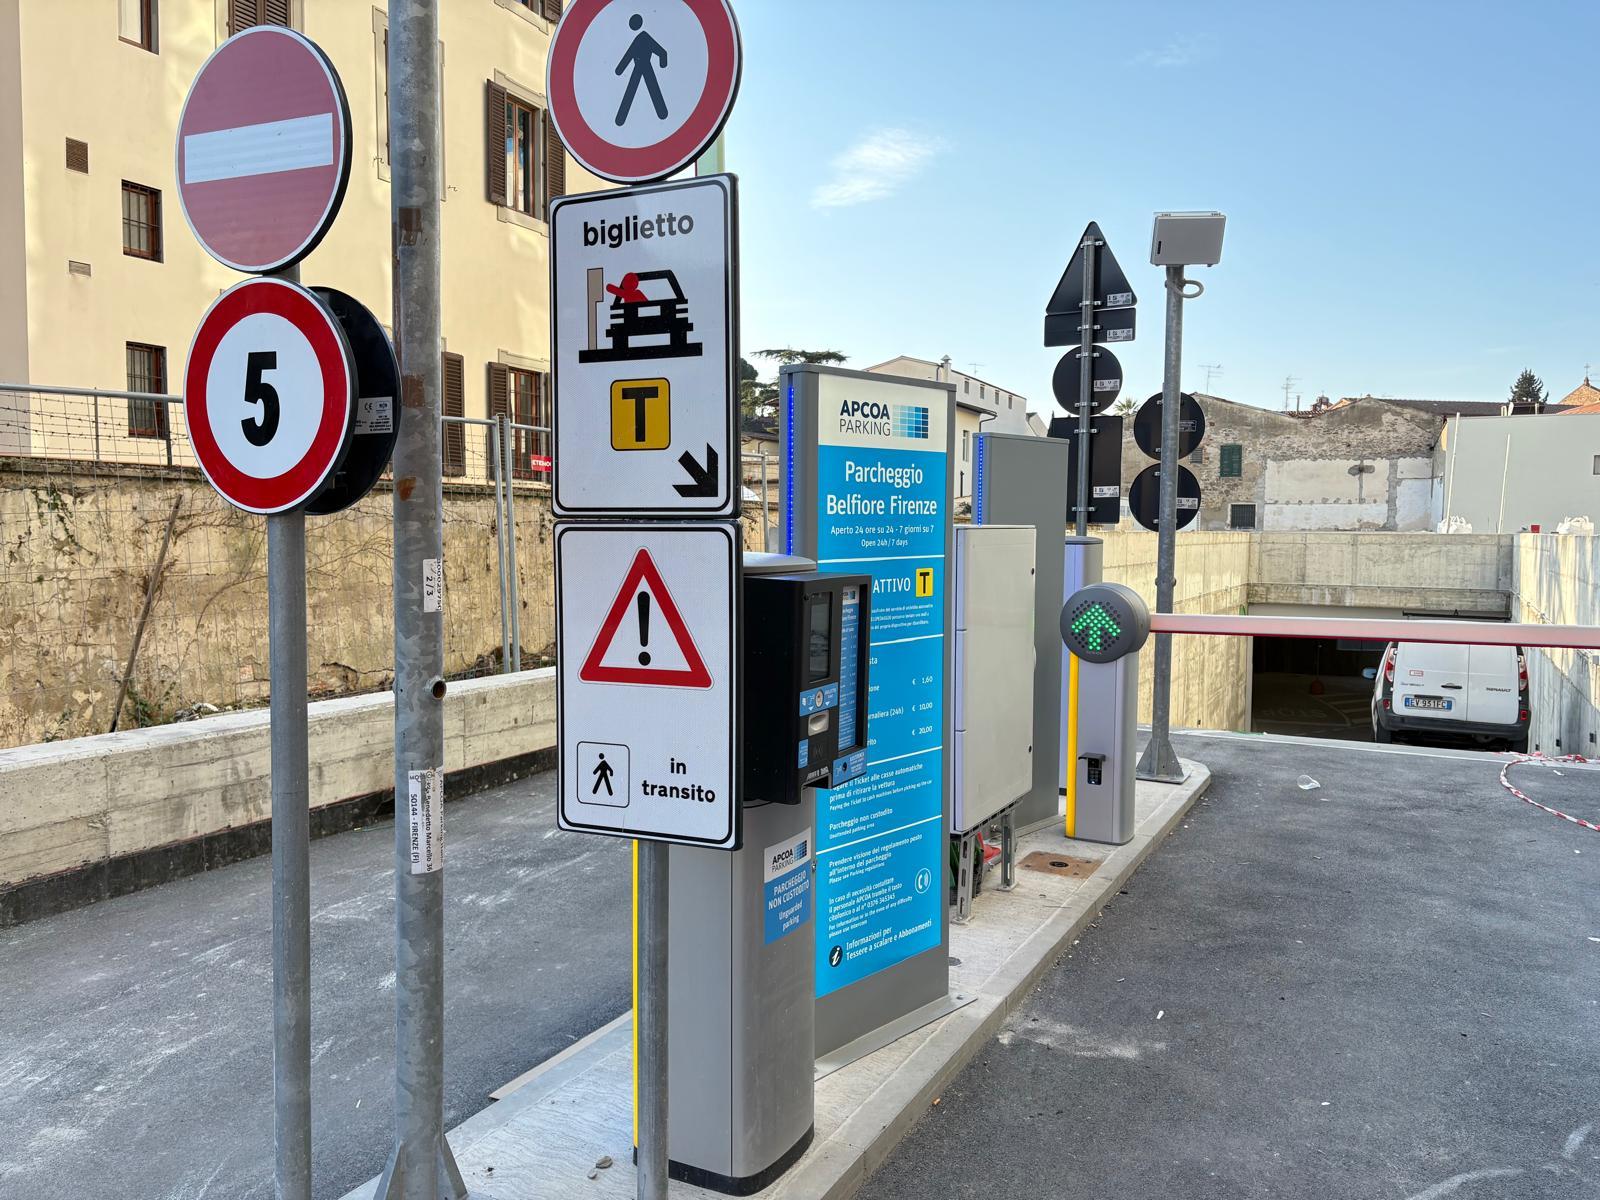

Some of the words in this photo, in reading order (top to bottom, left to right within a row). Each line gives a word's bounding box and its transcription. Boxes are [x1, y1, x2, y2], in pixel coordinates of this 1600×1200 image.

[583, 212, 694, 249] biglietto
[241, 351, 280, 447] 5
[621, 386, 658, 442] T
[840, 400, 890, 420] APCOA
[840, 418, 891, 436] PARKING
[845, 461, 923, 488] Parcheggio
[827, 494, 885, 515] Belfiore
[890, 495, 937, 515] Firenze
[830, 526, 854, 536] Aperto
[855, 526, 863, 534] 24
[904, 526, 921, 534] giorni
[861, 539, 876, 548] Open
[896, 538, 908, 547] days
[873, 578, 911, 594] ATTIVO
[919, 572, 930, 594] T
[670, 758, 686, 774] in
[642, 780, 716, 802] transito
[830, 817, 858, 831] Parcheggio
[860, 814, 869, 822] non
[870, 808, 893, 819] custodito
[412, 852, 420, 863] (FI)
[772, 848, 793, 864] APCOA
[772, 857, 794, 872] PARKING
[426, 863, 433, 872] 36
[774, 870, 806, 896] PARCHEGGIO
[768, 897, 781, 910] NON
[783, 879, 810, 903] CUSTODITO
[779, 899, 802, 920] Unguarded
[783, 915, 799, 932] parking
[846, 930, 882, 950] Informazioni
[882, 927, 892, 937] per
[846, 949, 868, 961] Tessere
[874, 937, 893, 948] scalare
[899, 918, 932, 939] Abbonamenti
